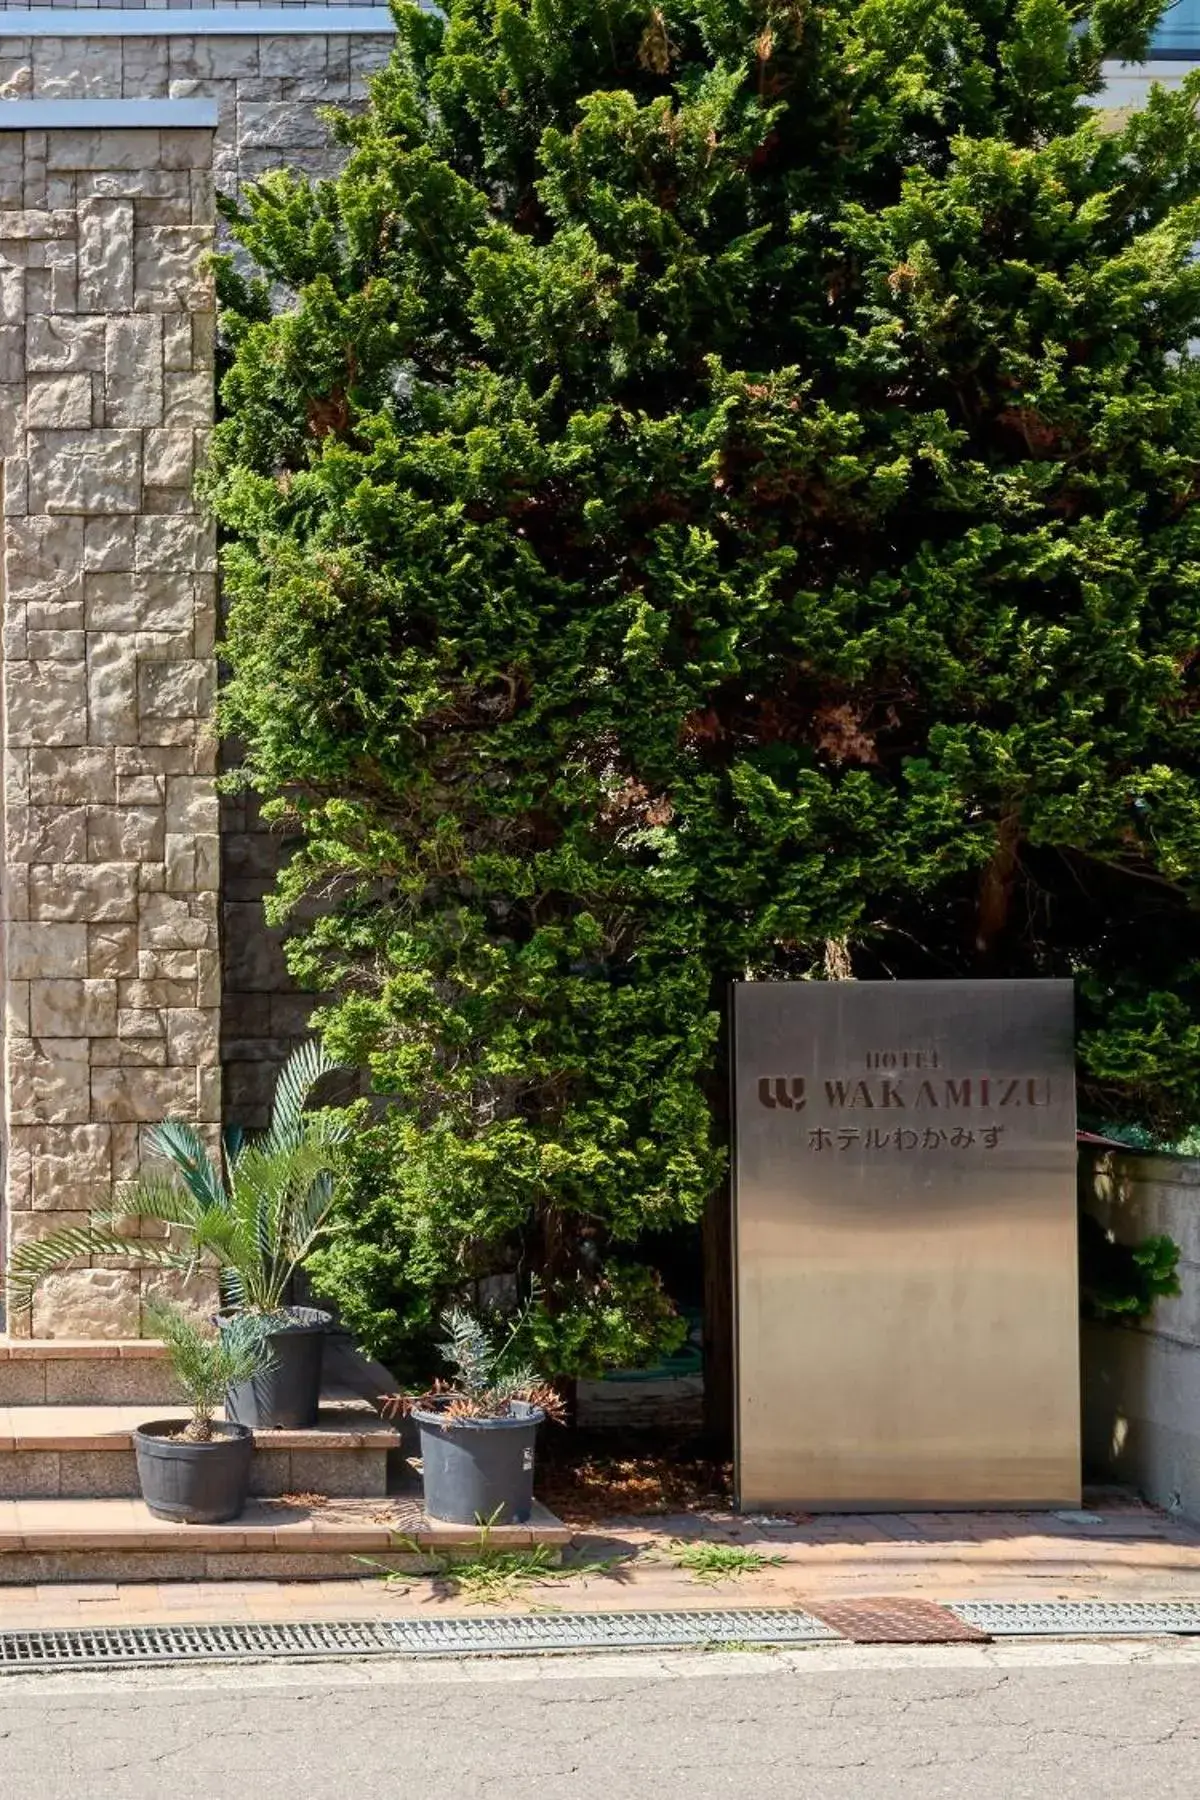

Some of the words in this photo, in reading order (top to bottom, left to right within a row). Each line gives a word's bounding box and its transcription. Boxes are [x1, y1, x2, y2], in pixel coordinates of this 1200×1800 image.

[865, 1049, 940, 1069] HOTEL
[824, 1078, 1051, 1108] WAKAMIZU
[808, 1126, 1005, 1151] ホテルわかみず
